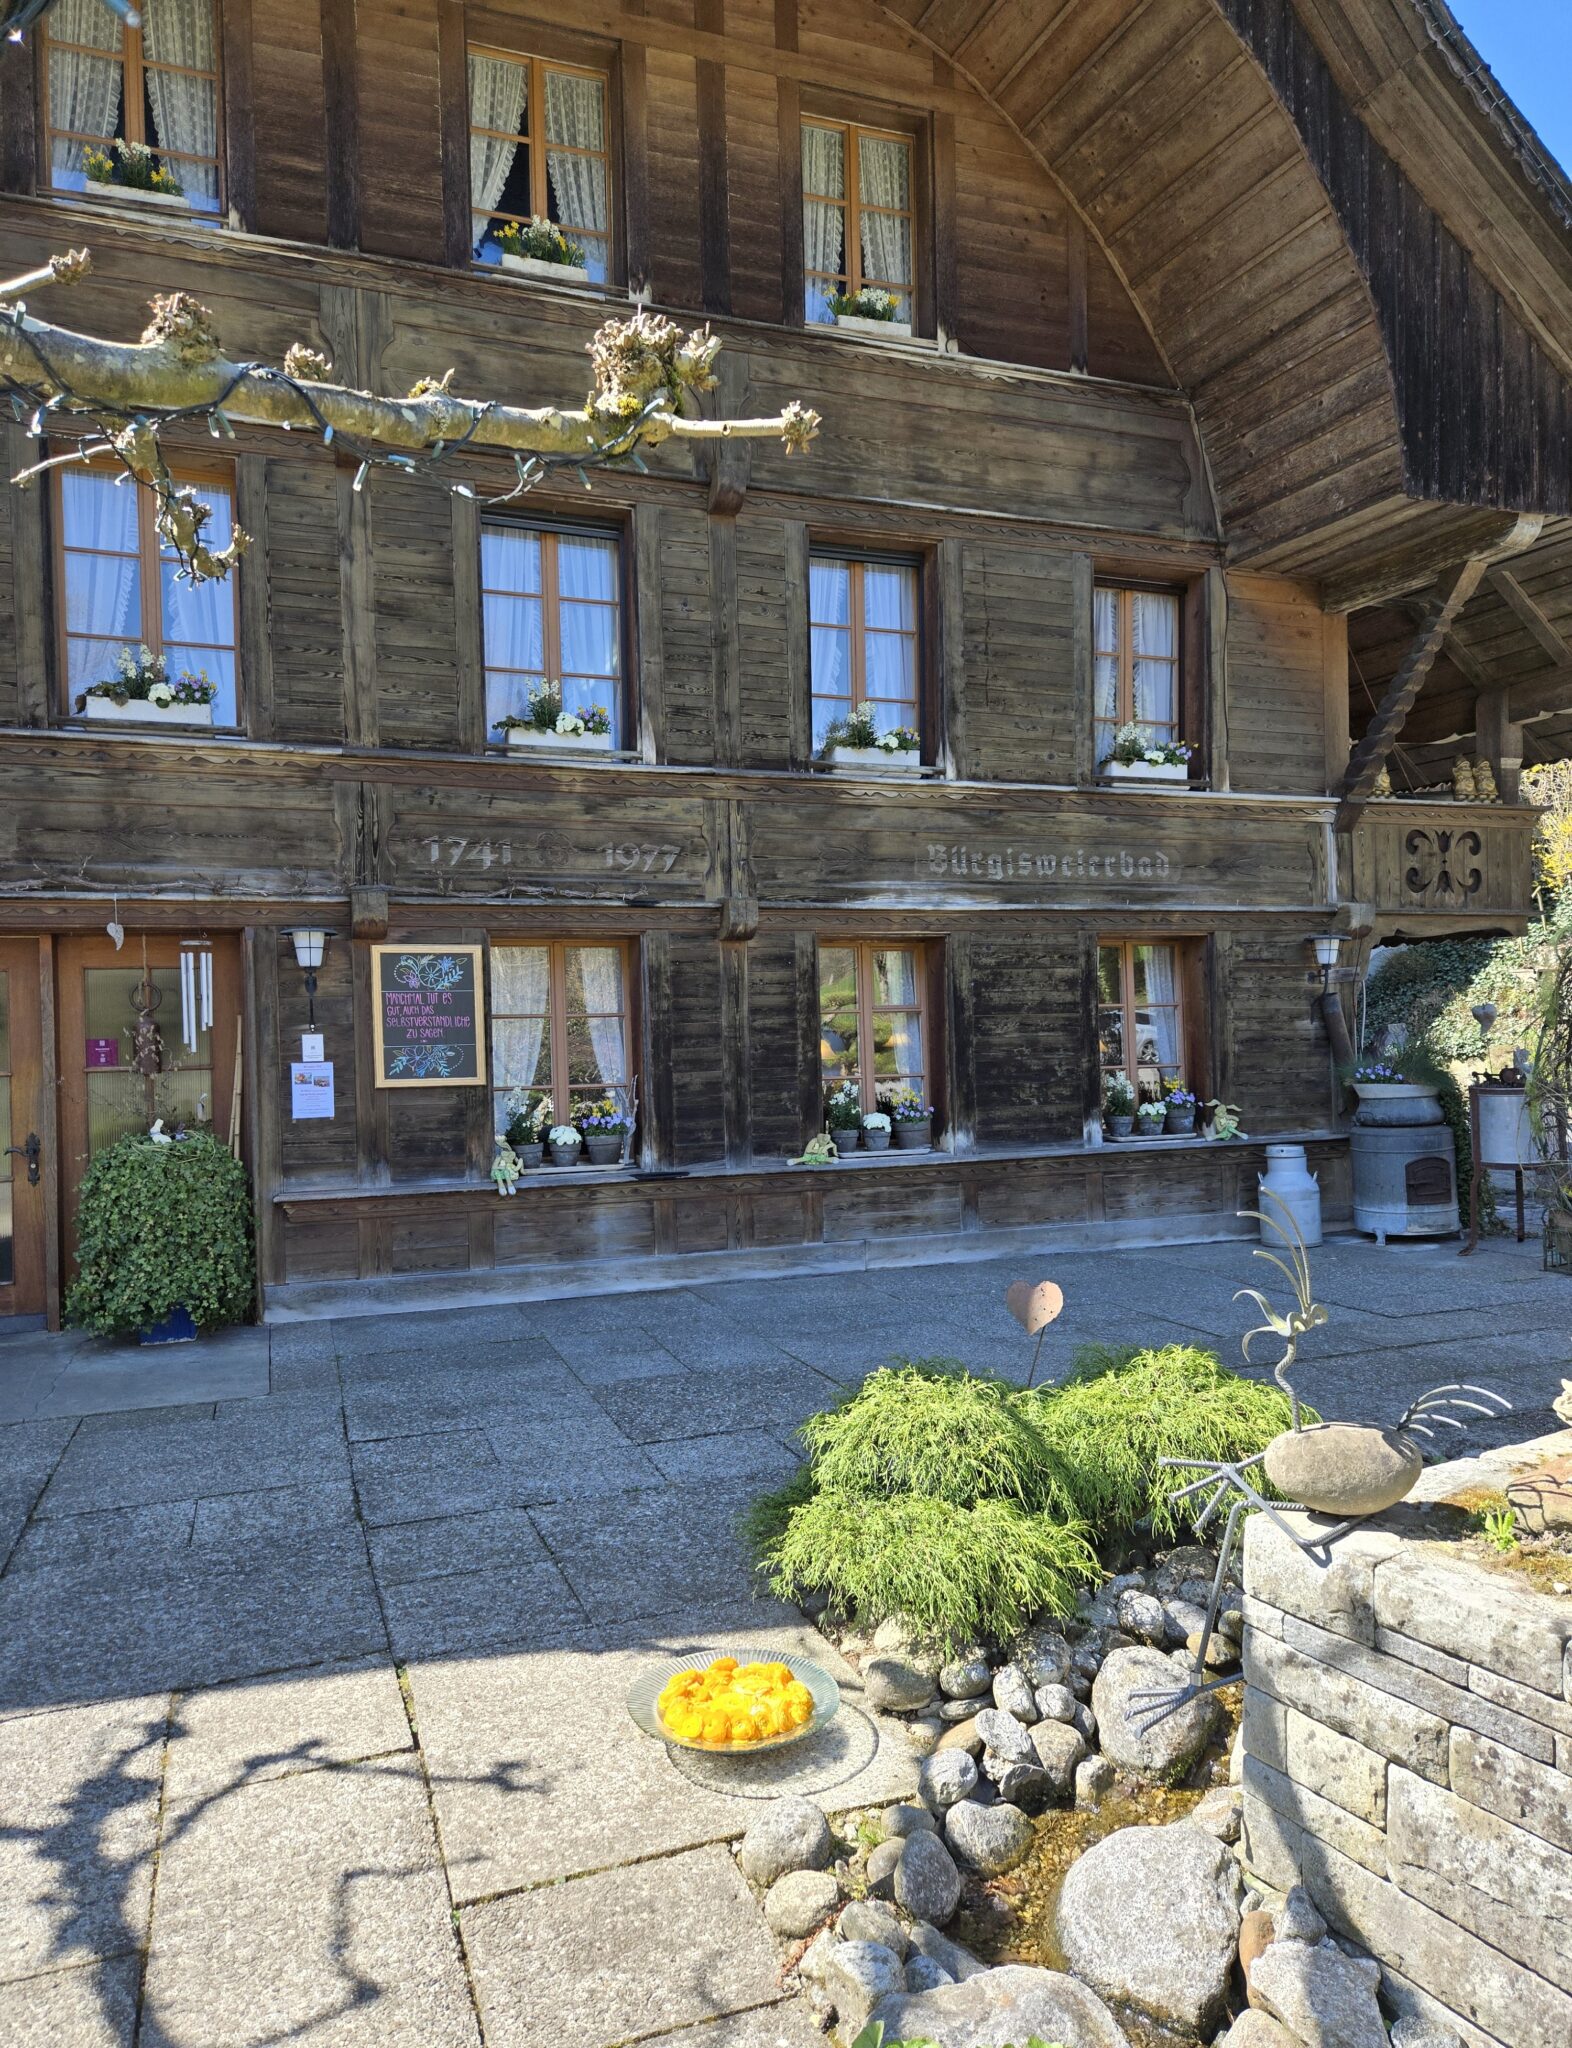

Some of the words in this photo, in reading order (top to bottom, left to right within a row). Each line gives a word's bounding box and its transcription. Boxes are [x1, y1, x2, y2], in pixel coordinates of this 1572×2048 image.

[421, 836, 513, 870] 1741
[599, 841, 682, 873] 1977
[926, 844, 1171, 880] Bürgisweierbad
[385, 992, 425, 1005] MANCHMAL
[426, 992, 439, 1005] TUT
[402, 1005, 420, 1016] AUCH
[421, 1005, 435, 1016] DAS
[406, 1028, 418, 1039] ZU
